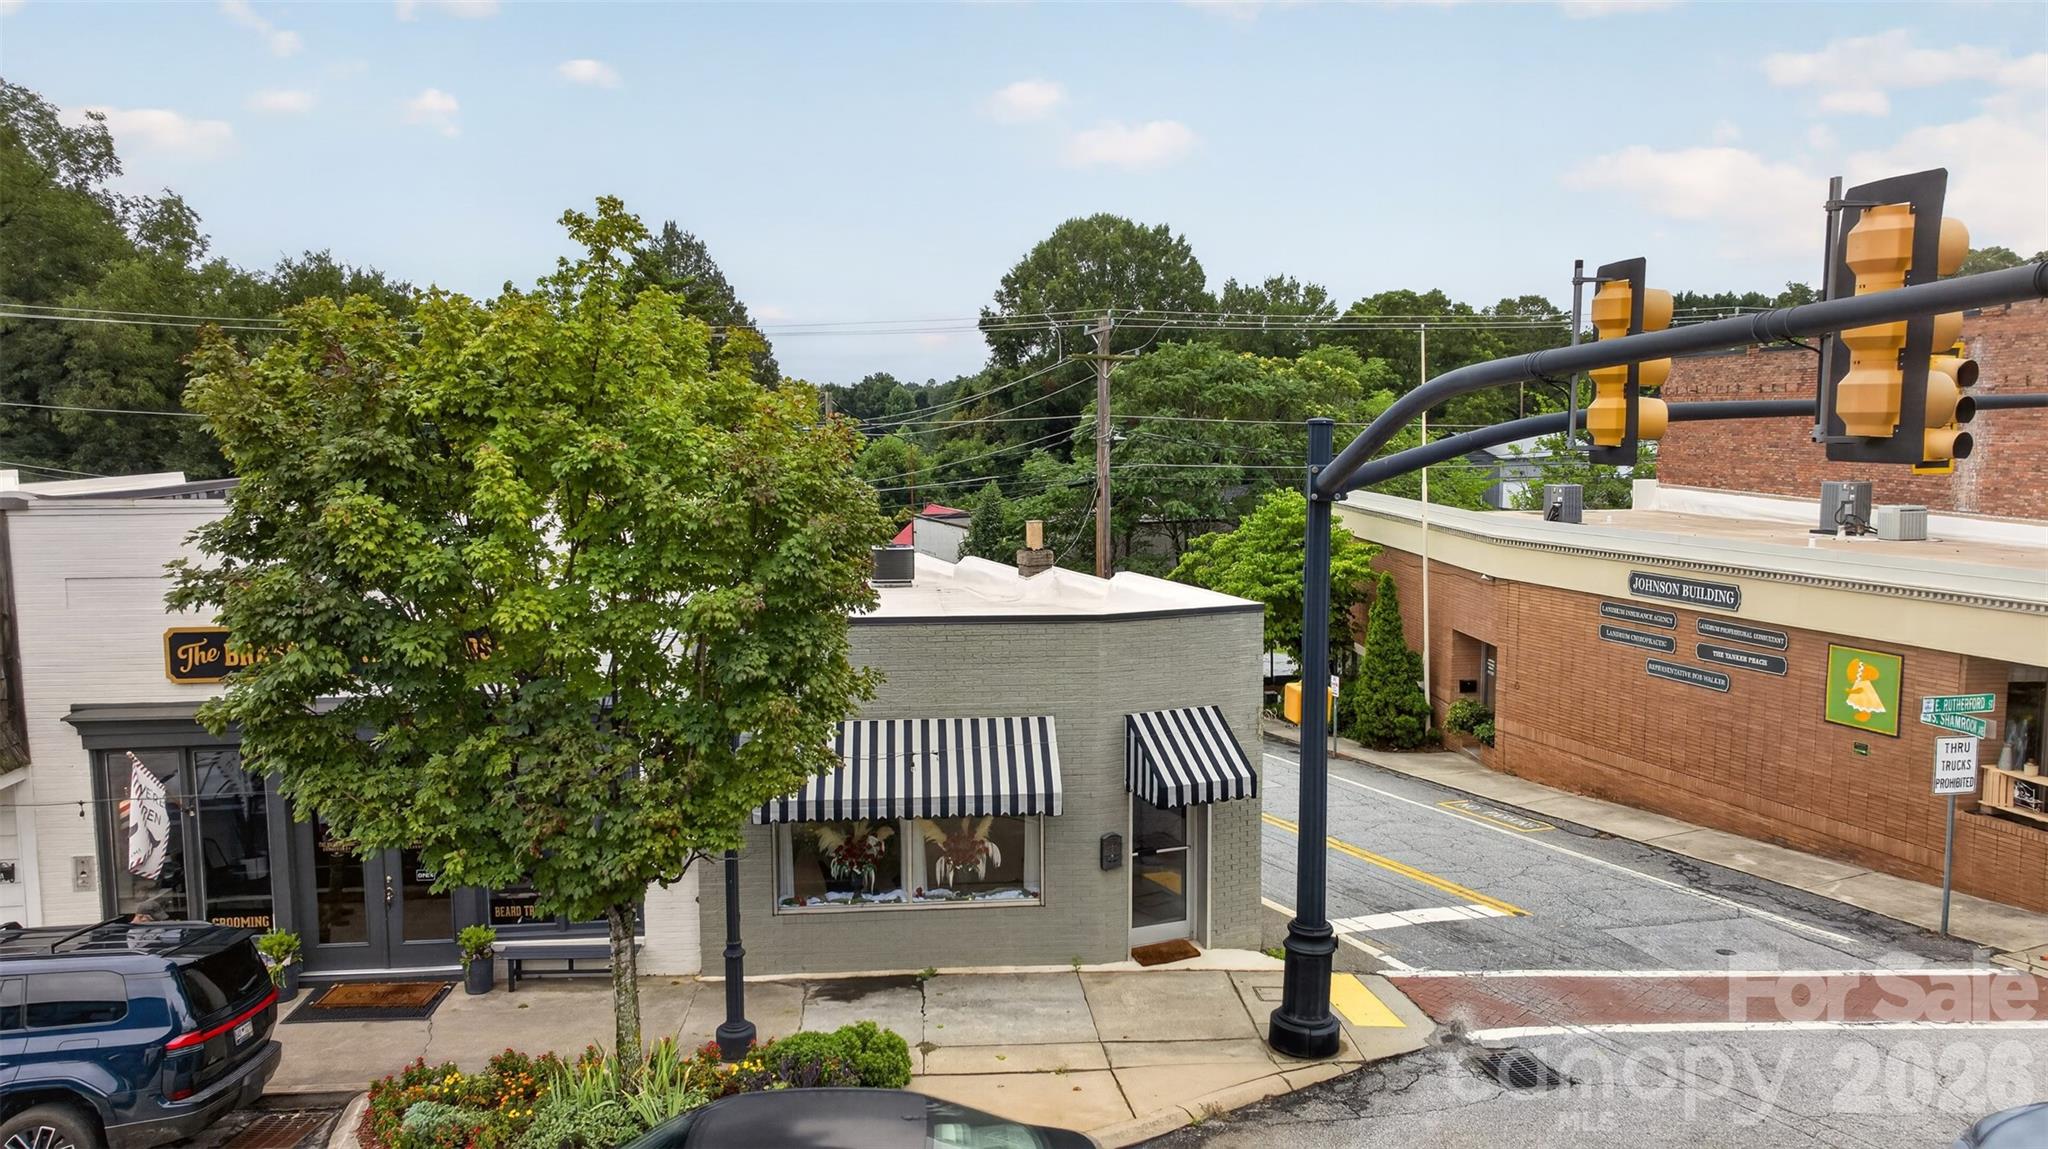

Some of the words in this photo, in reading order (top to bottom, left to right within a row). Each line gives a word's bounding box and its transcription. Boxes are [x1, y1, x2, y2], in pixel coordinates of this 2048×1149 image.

[1632, 576, 1680, 596] JOHNSON
[1682, 583, 1735, 605] BUILDING
[1653, 615, 1674, 624] AGENCY
[1606, 629, 1631, 641] LANDRUM
[177, 637, 221, 673] The
[1712, 650, 1724, 658] THE
[1703, 675, 1726, 686] WALKER
[1943, 697, 1985, 712] RUTHERFORD
[1940, 714, 1977, 734] SHAMROCK
[1945, 742, 1971, 754] THRU
[1941, 760, 1972, 771] TRUCKS
[1935, 777, 1975, 789] PROHIBITED
[494, 905, 522, 918] BEARD
[211, 915, 270, 928] GROOMING
